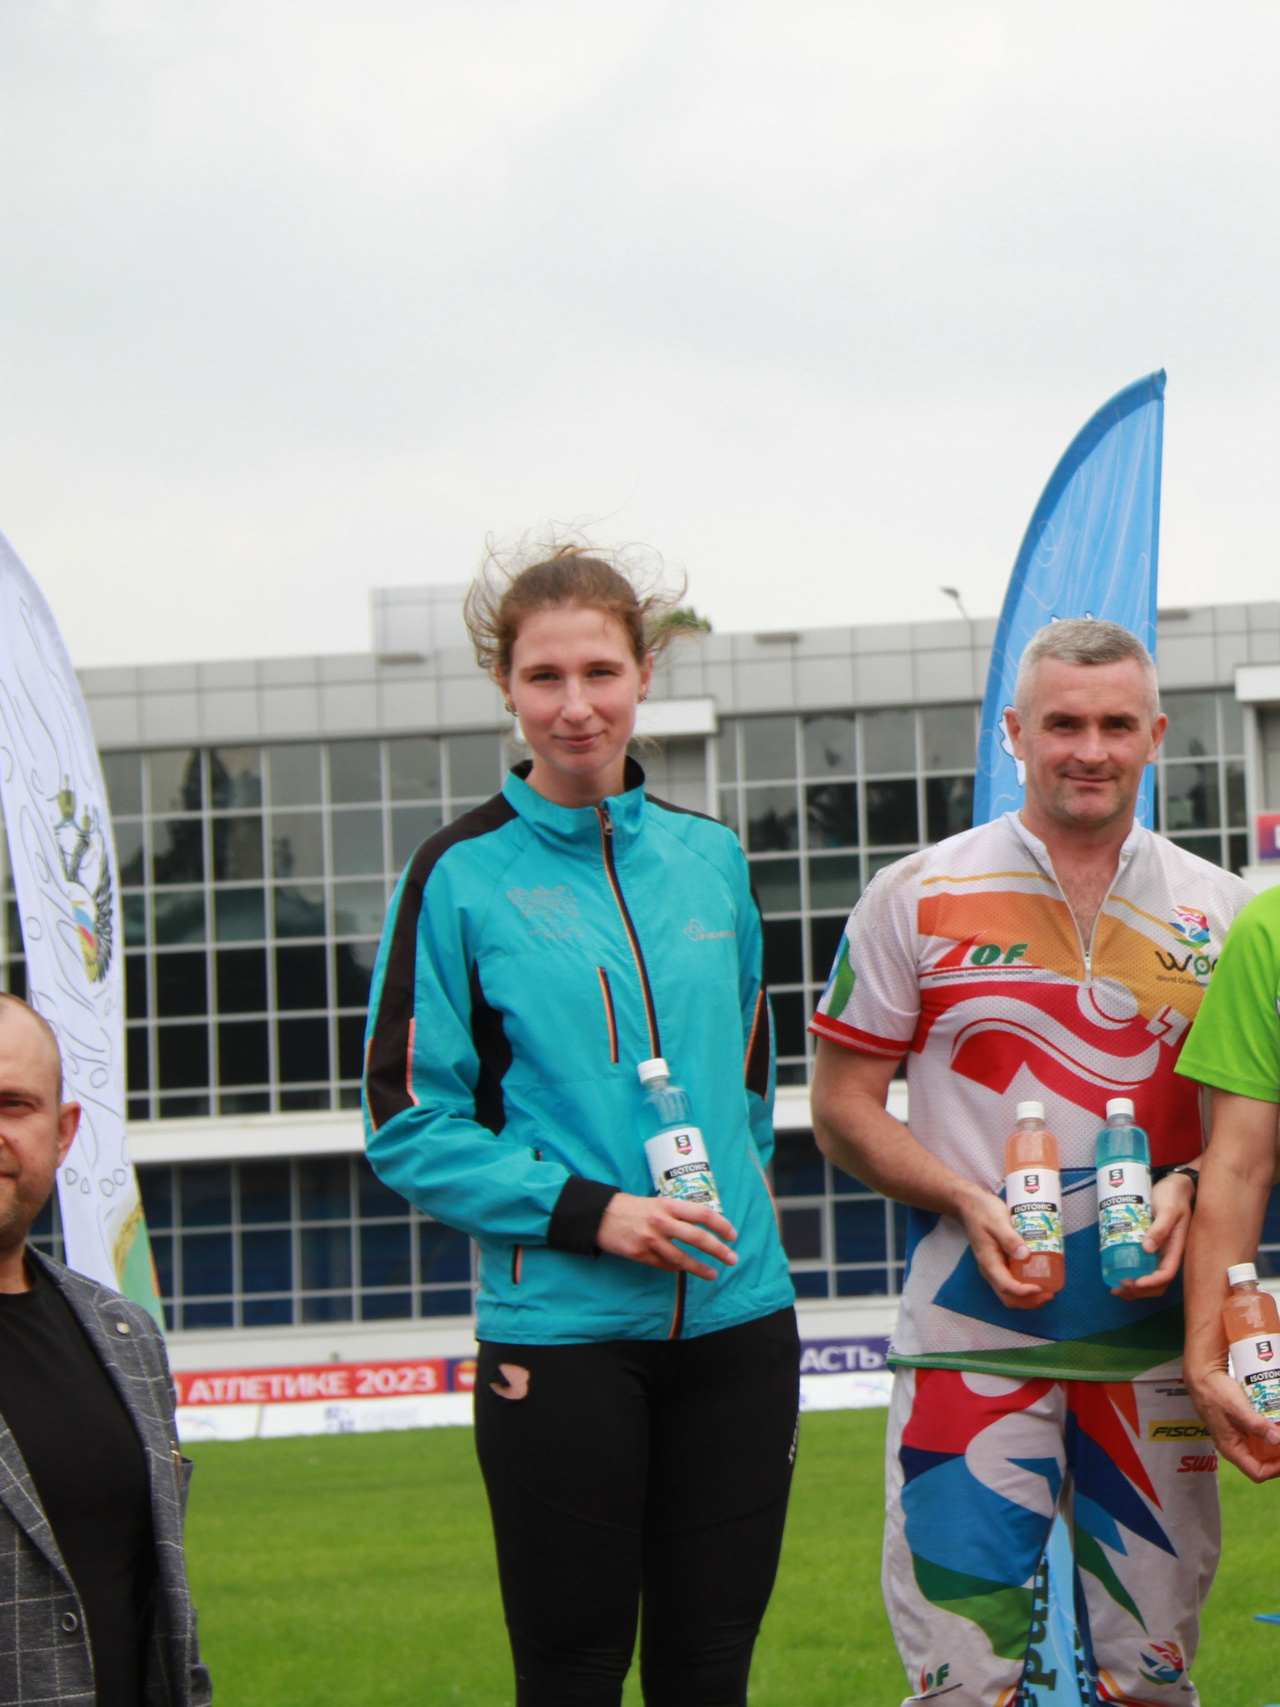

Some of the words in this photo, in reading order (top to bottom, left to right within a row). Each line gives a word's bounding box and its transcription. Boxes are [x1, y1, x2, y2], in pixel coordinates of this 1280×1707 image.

[669, 1163, 707, 1178] ISOTONIC
[1014, 1203, 1052, 1213] ISOTONIC
[1101, 1196, 1137, 1208] ISOTONIC
[800, 1345, 884, 1372] АСТЬ
[187, 1370, 350, 1404] АТЛЕТИКЕ
[355, 1366, 436, 1395] 2023
